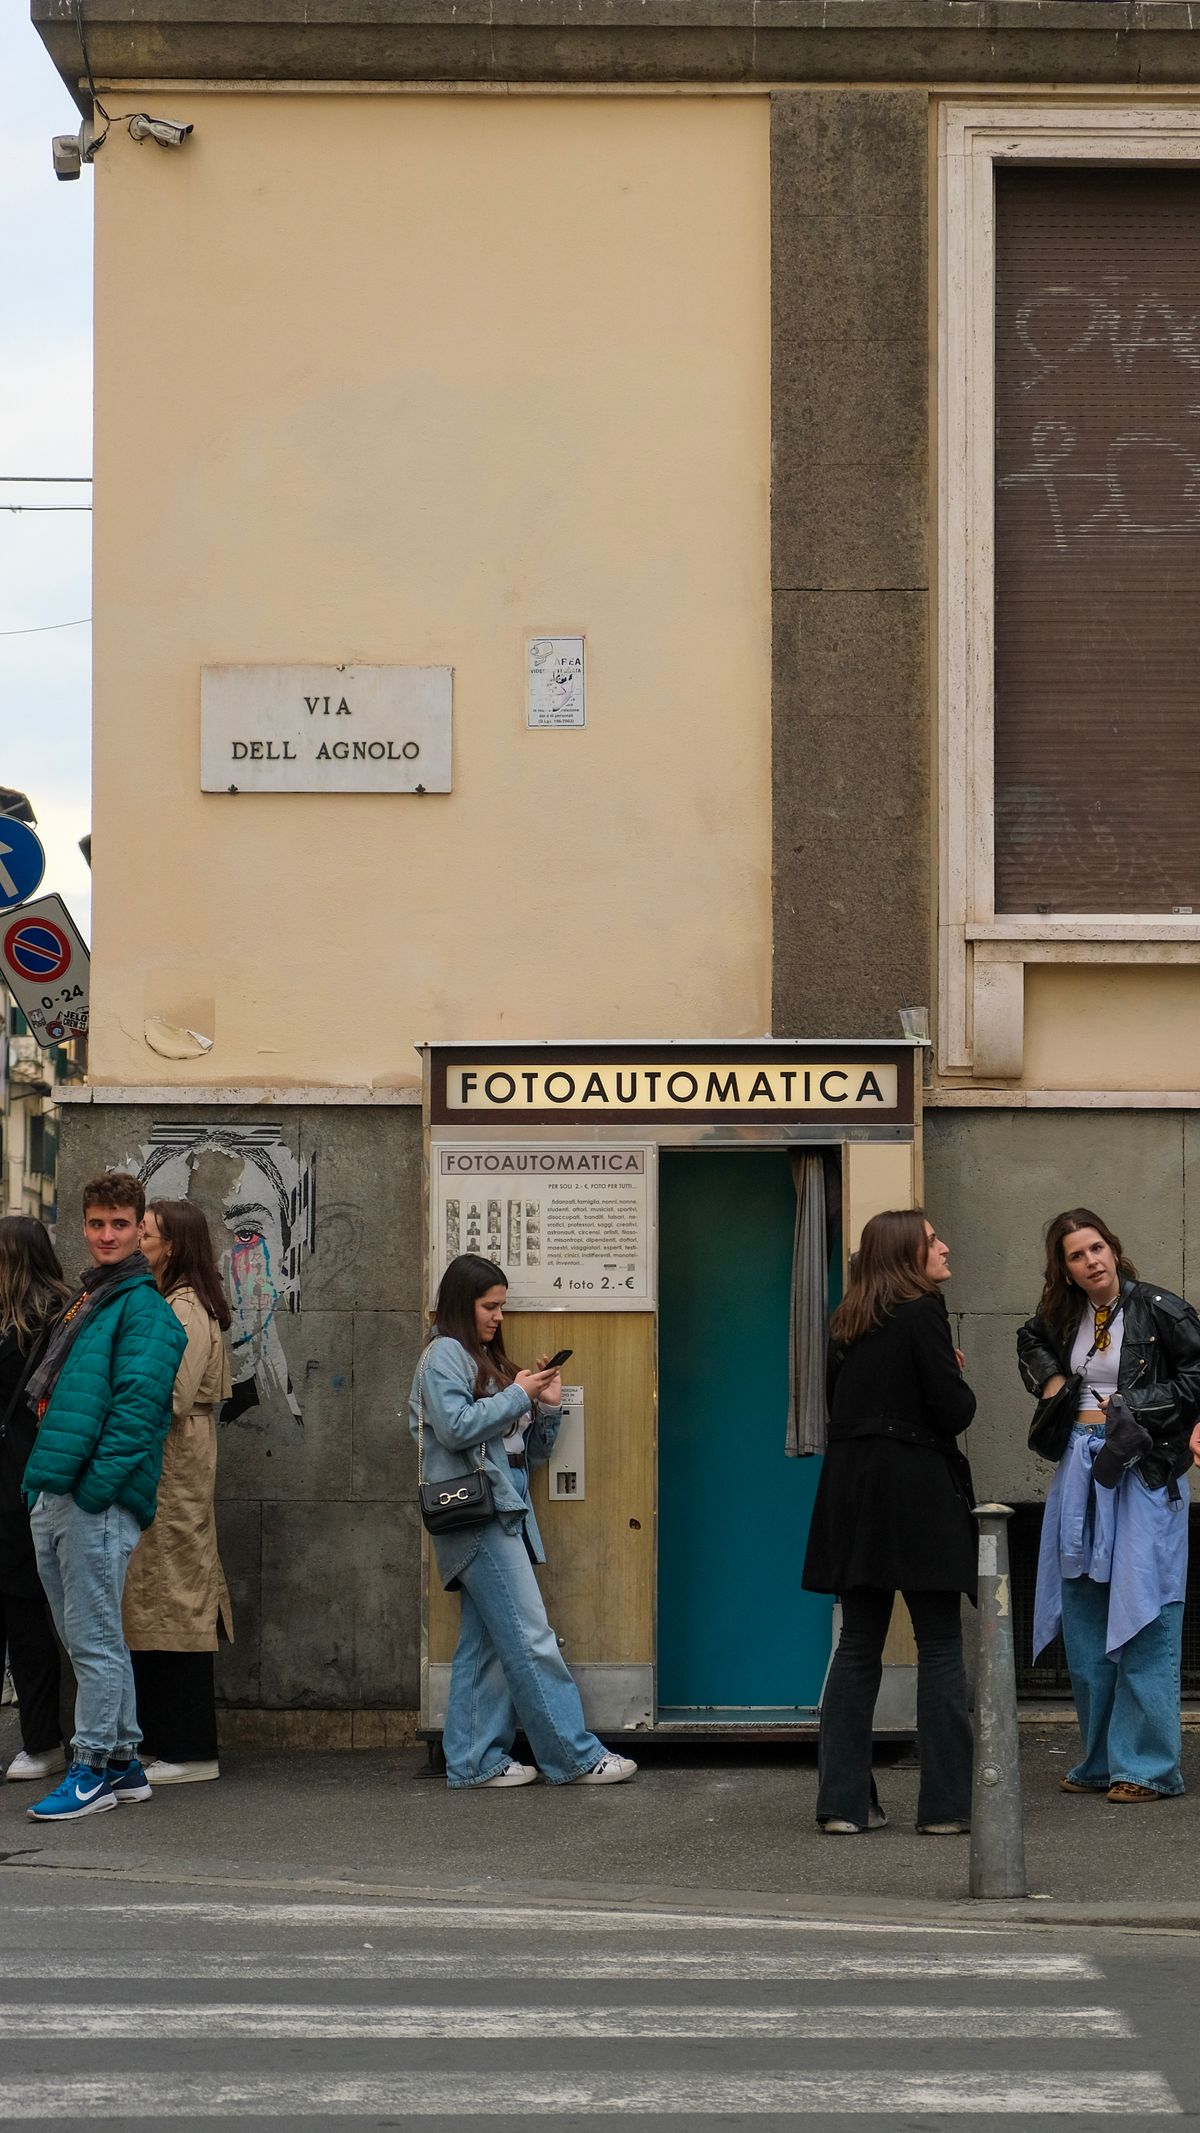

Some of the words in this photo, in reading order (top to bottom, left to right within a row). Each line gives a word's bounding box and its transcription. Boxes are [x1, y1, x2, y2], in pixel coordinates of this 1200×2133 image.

[303, 696, 352, 715] VIA
[231, 740, 298, 761] DELL
[315, 740, 421, 761] AGNOLO
[41, 984, 84, 1010] 0-24
[460, 1071, 885, 1104] FOTOAUTOMATICA
[446, 1154, 640, 1171] FOTOAUTOMATICA
[552, 1276, 563, 1290] 4
[569, 1279, 594, 1290] foto
